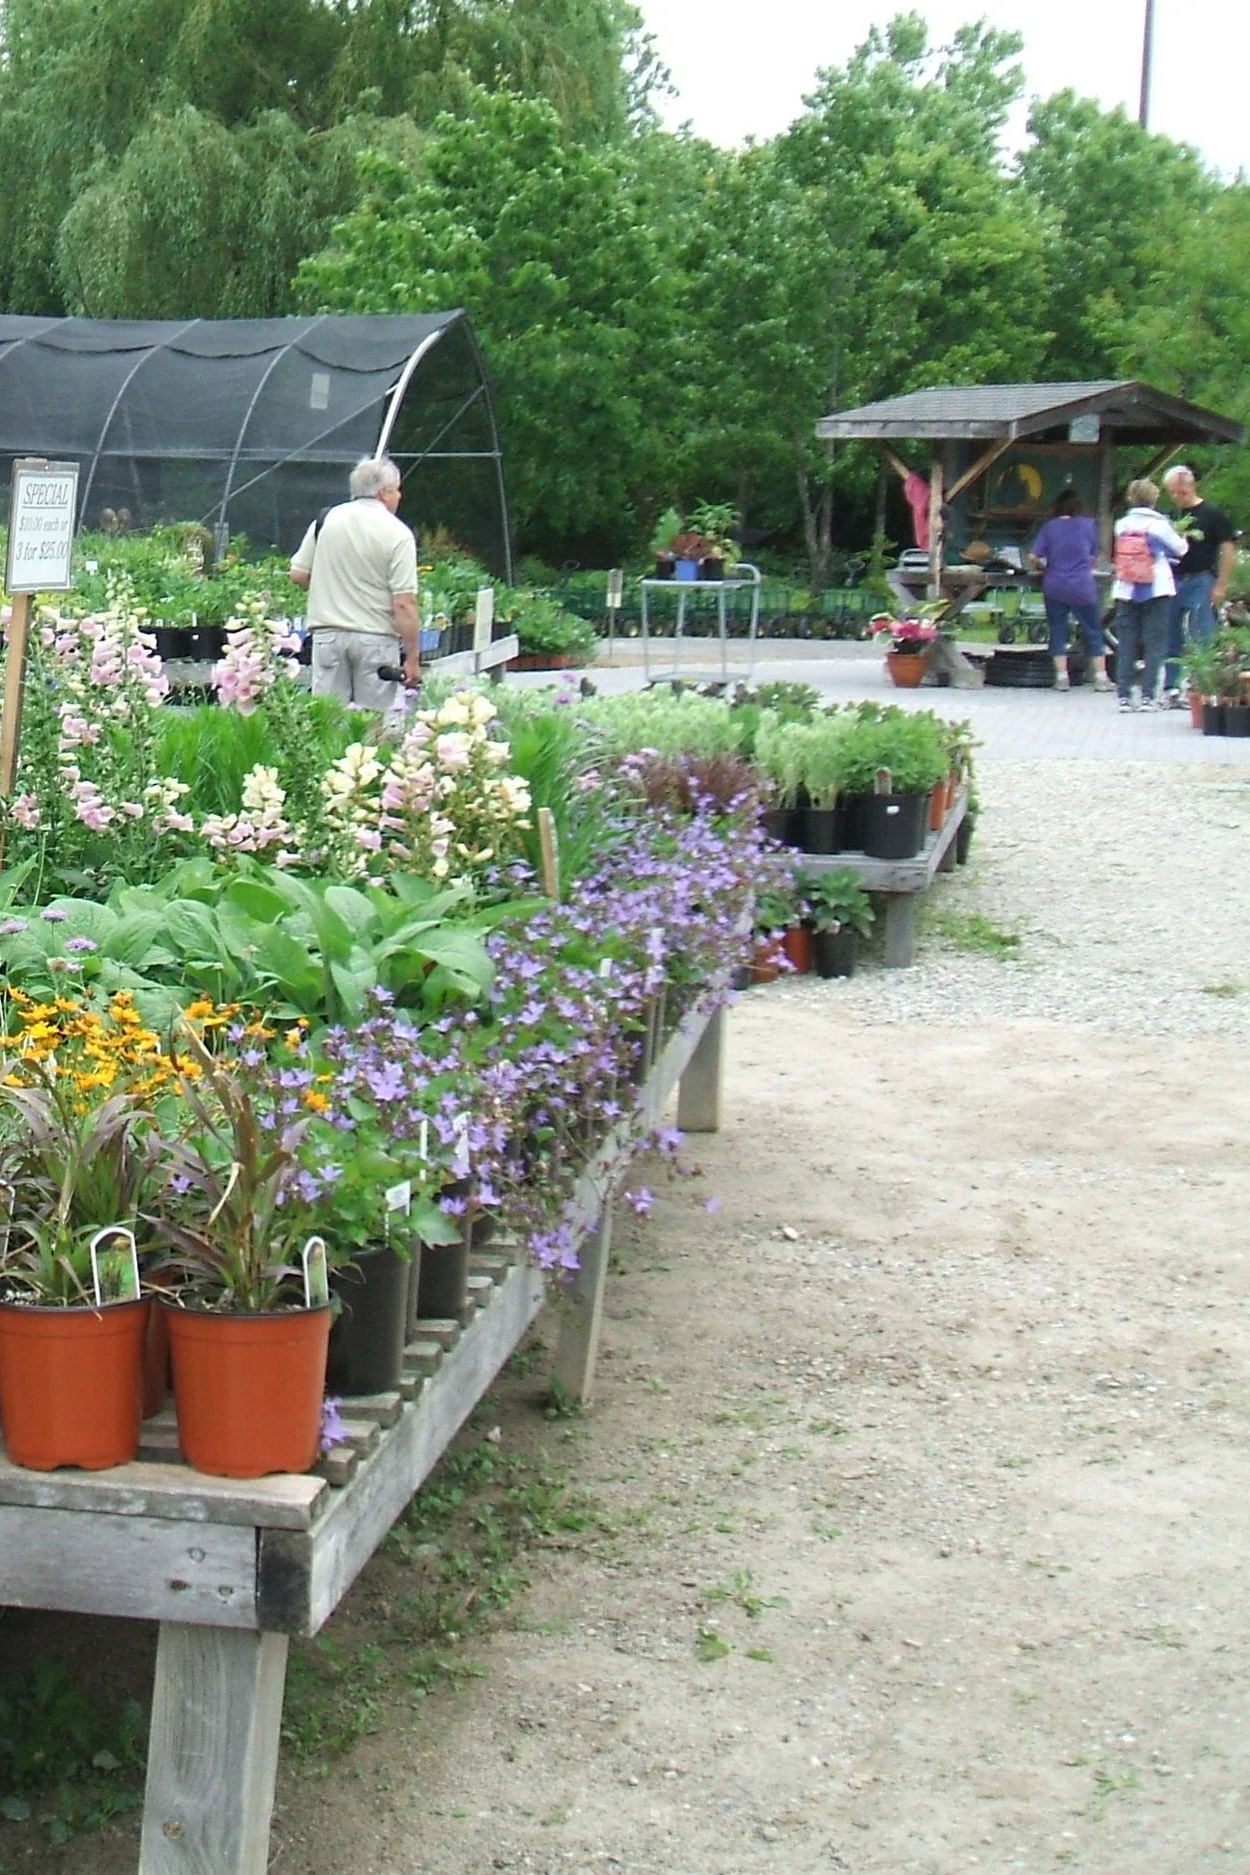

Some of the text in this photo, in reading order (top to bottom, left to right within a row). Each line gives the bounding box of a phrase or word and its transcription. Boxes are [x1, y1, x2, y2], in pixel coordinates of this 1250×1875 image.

[23, 483, 69, 505] SPECIAL
[19, 516, 69, 531] $10.00 each or
[16, 540, 69, 560] 3 for $25.00
